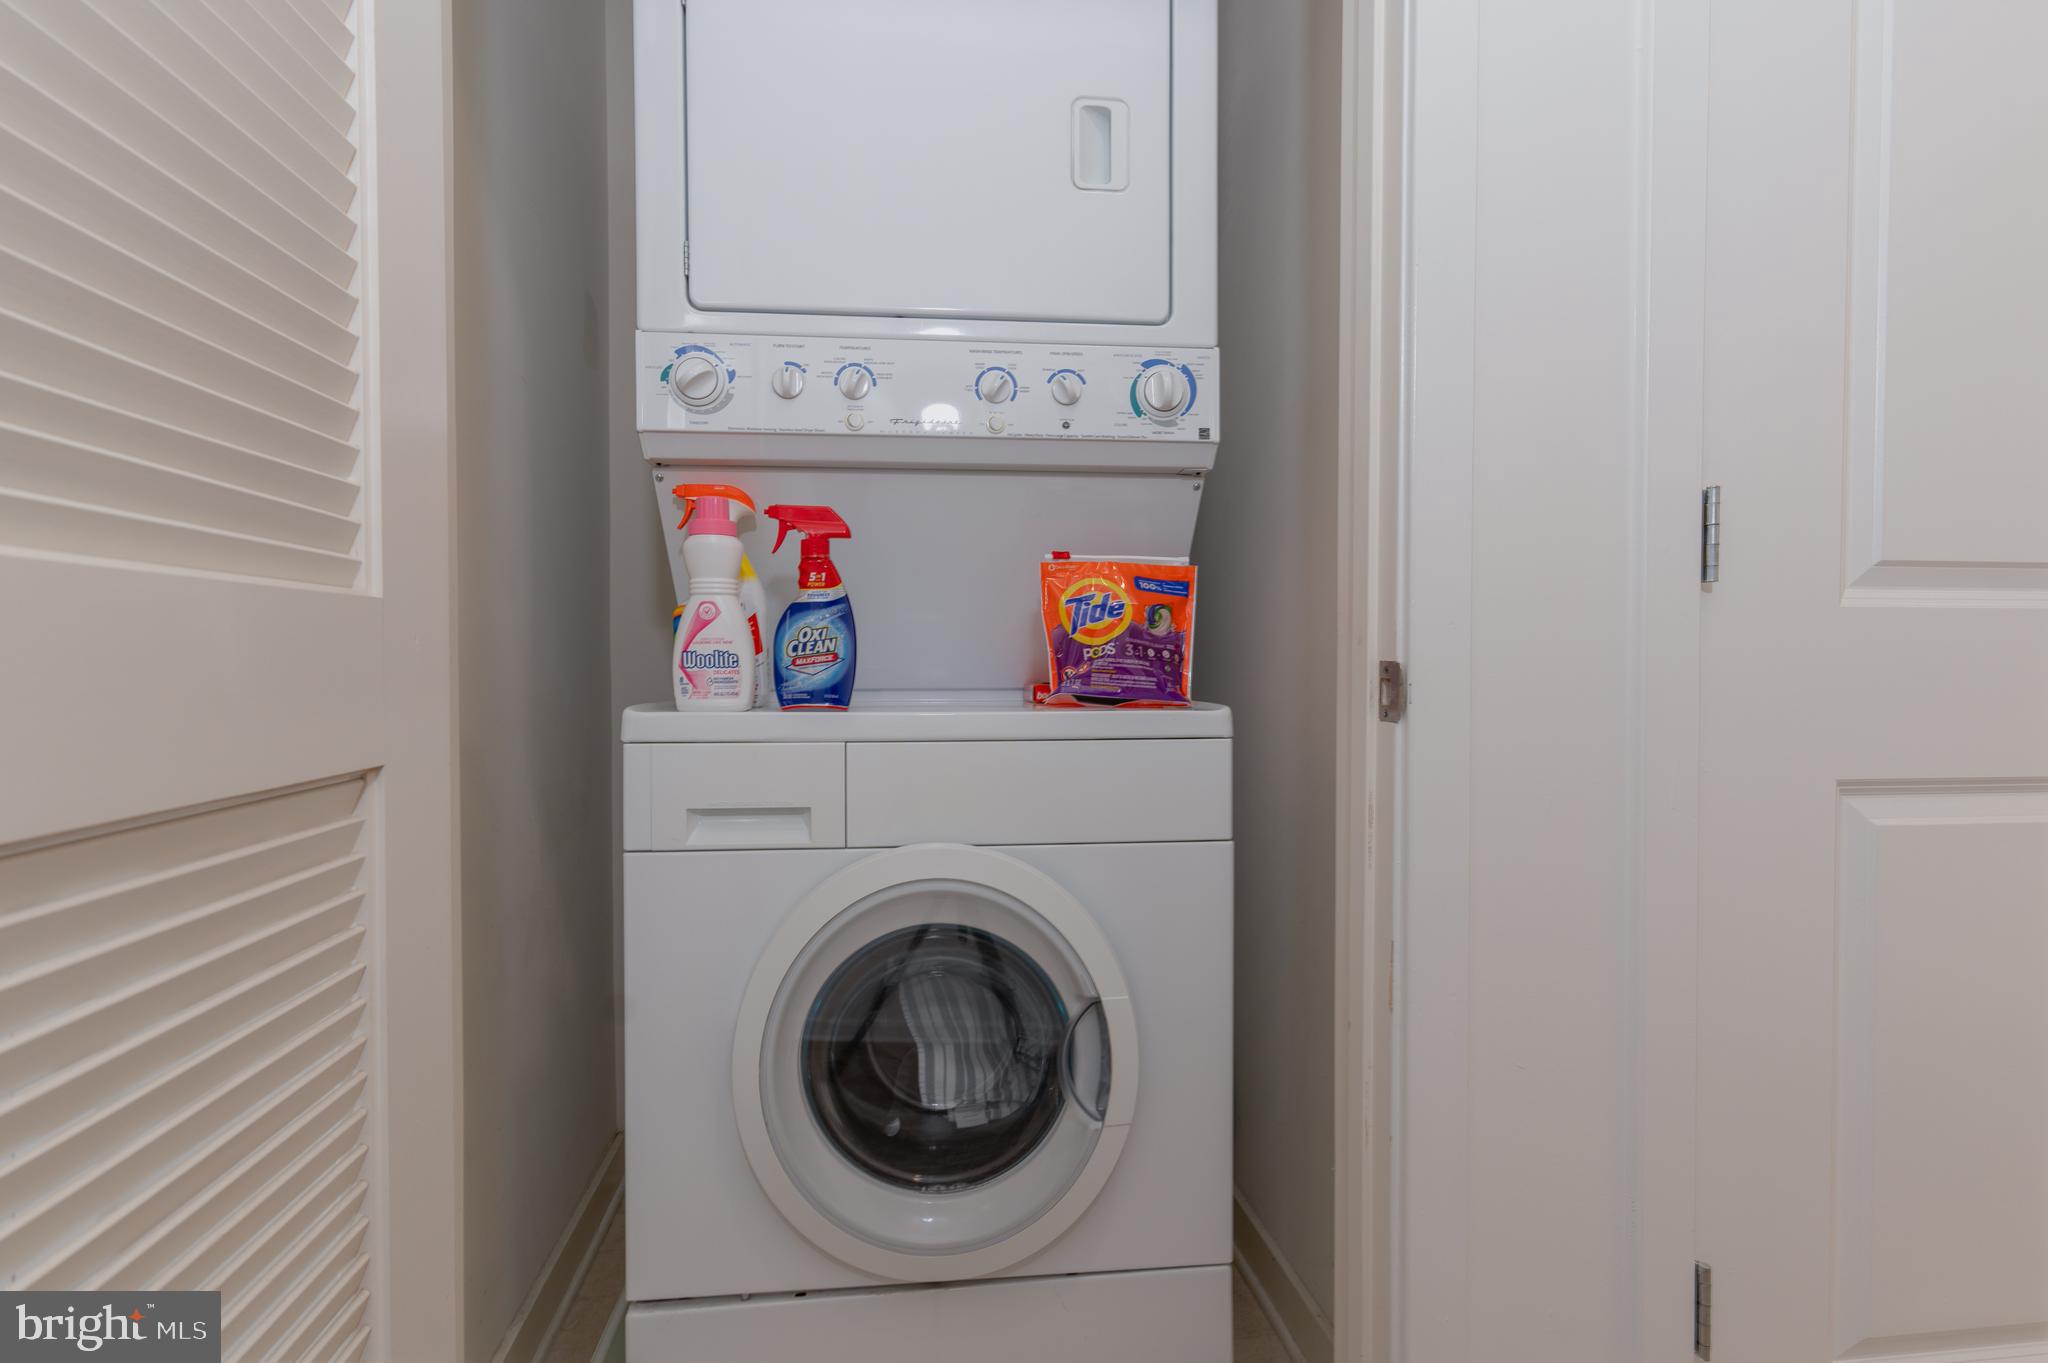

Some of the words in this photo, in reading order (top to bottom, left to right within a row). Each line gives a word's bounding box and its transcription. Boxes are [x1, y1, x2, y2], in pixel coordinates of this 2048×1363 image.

[1064, 591, 1126, 639] Tide
[798, 625, 829, 643] OXI
[785, 637, 838, 658] CLEAN
[682, 649, 740, 669] Woolite
